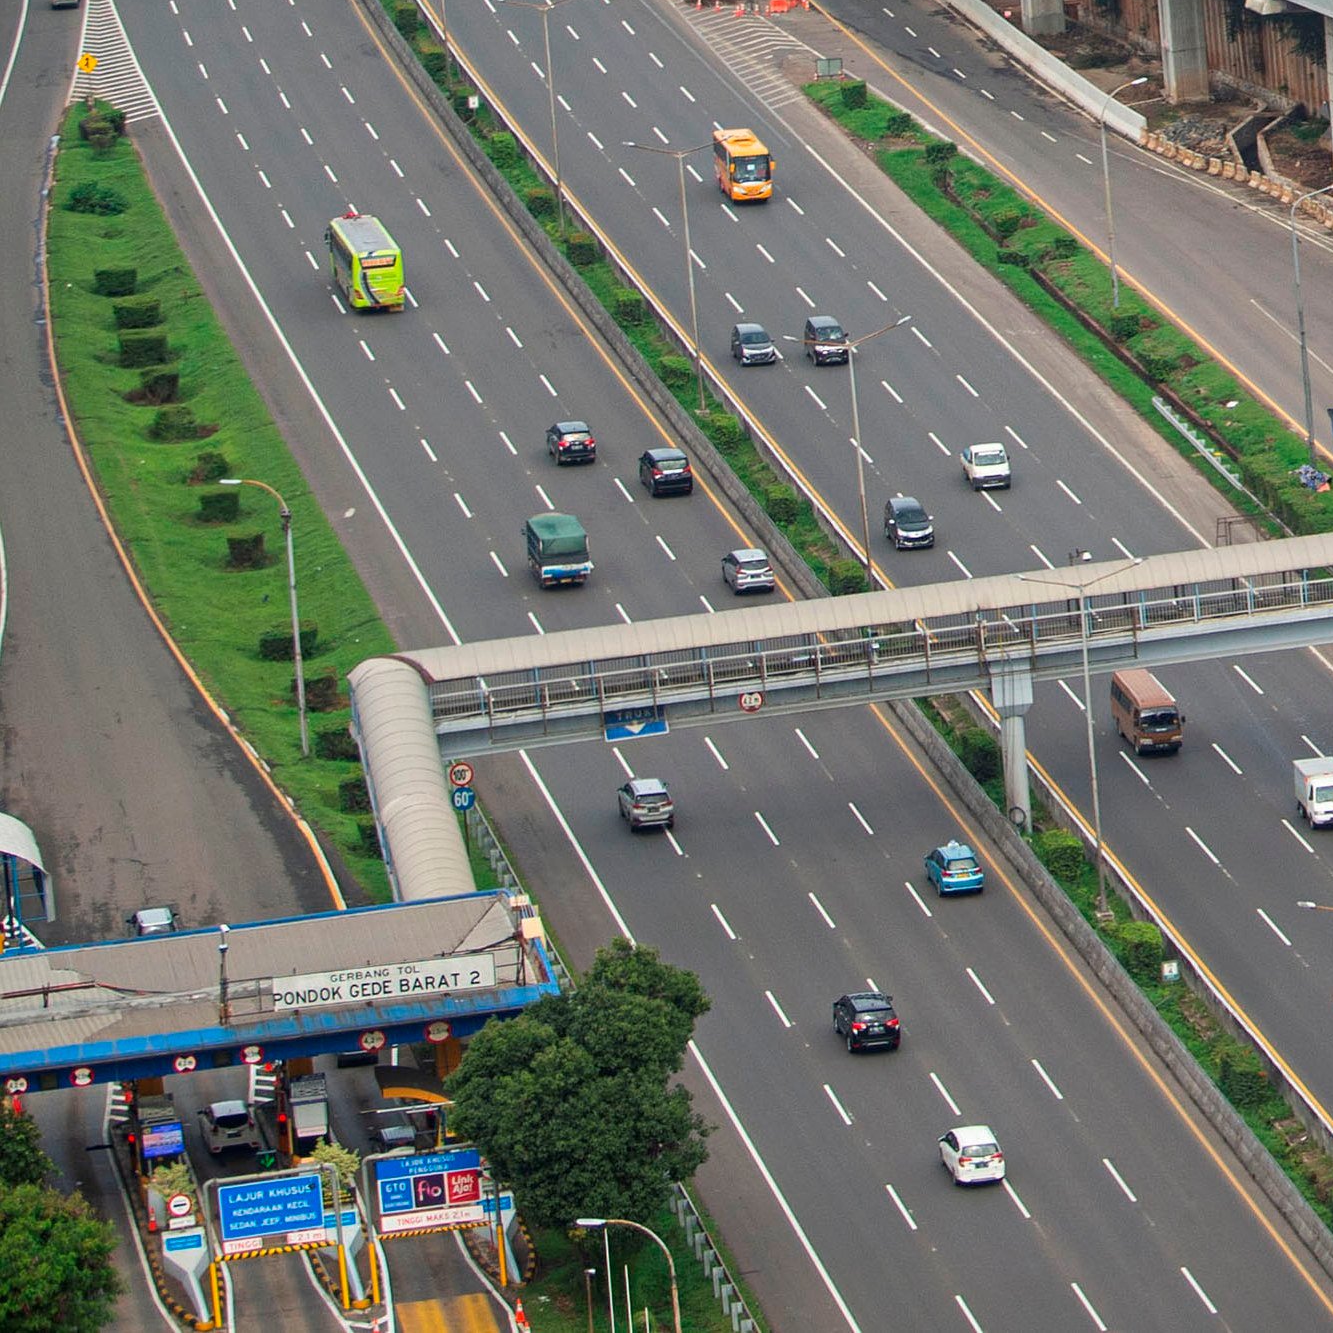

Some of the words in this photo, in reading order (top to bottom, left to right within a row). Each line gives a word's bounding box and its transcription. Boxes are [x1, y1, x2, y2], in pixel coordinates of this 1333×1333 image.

[454, 791, 469, 807] 60
[330, 968, 390, 983] GERBANG
[396, 965, 420, 975] TOL
[272, 986, 342, 1005] PONDOK
[349, 980, 393, 998] GEDE
[400, 972, 460, 992] BARAT
[470, 970, 481, 985] 2
[228, 1190, 264, 1204] LAJUR
[269, 1184, 312, 1197] KHUSUS
[232, 1203, 283, 1216] KENDARAAN
[287, 1200, 311, 1209] KECIL
